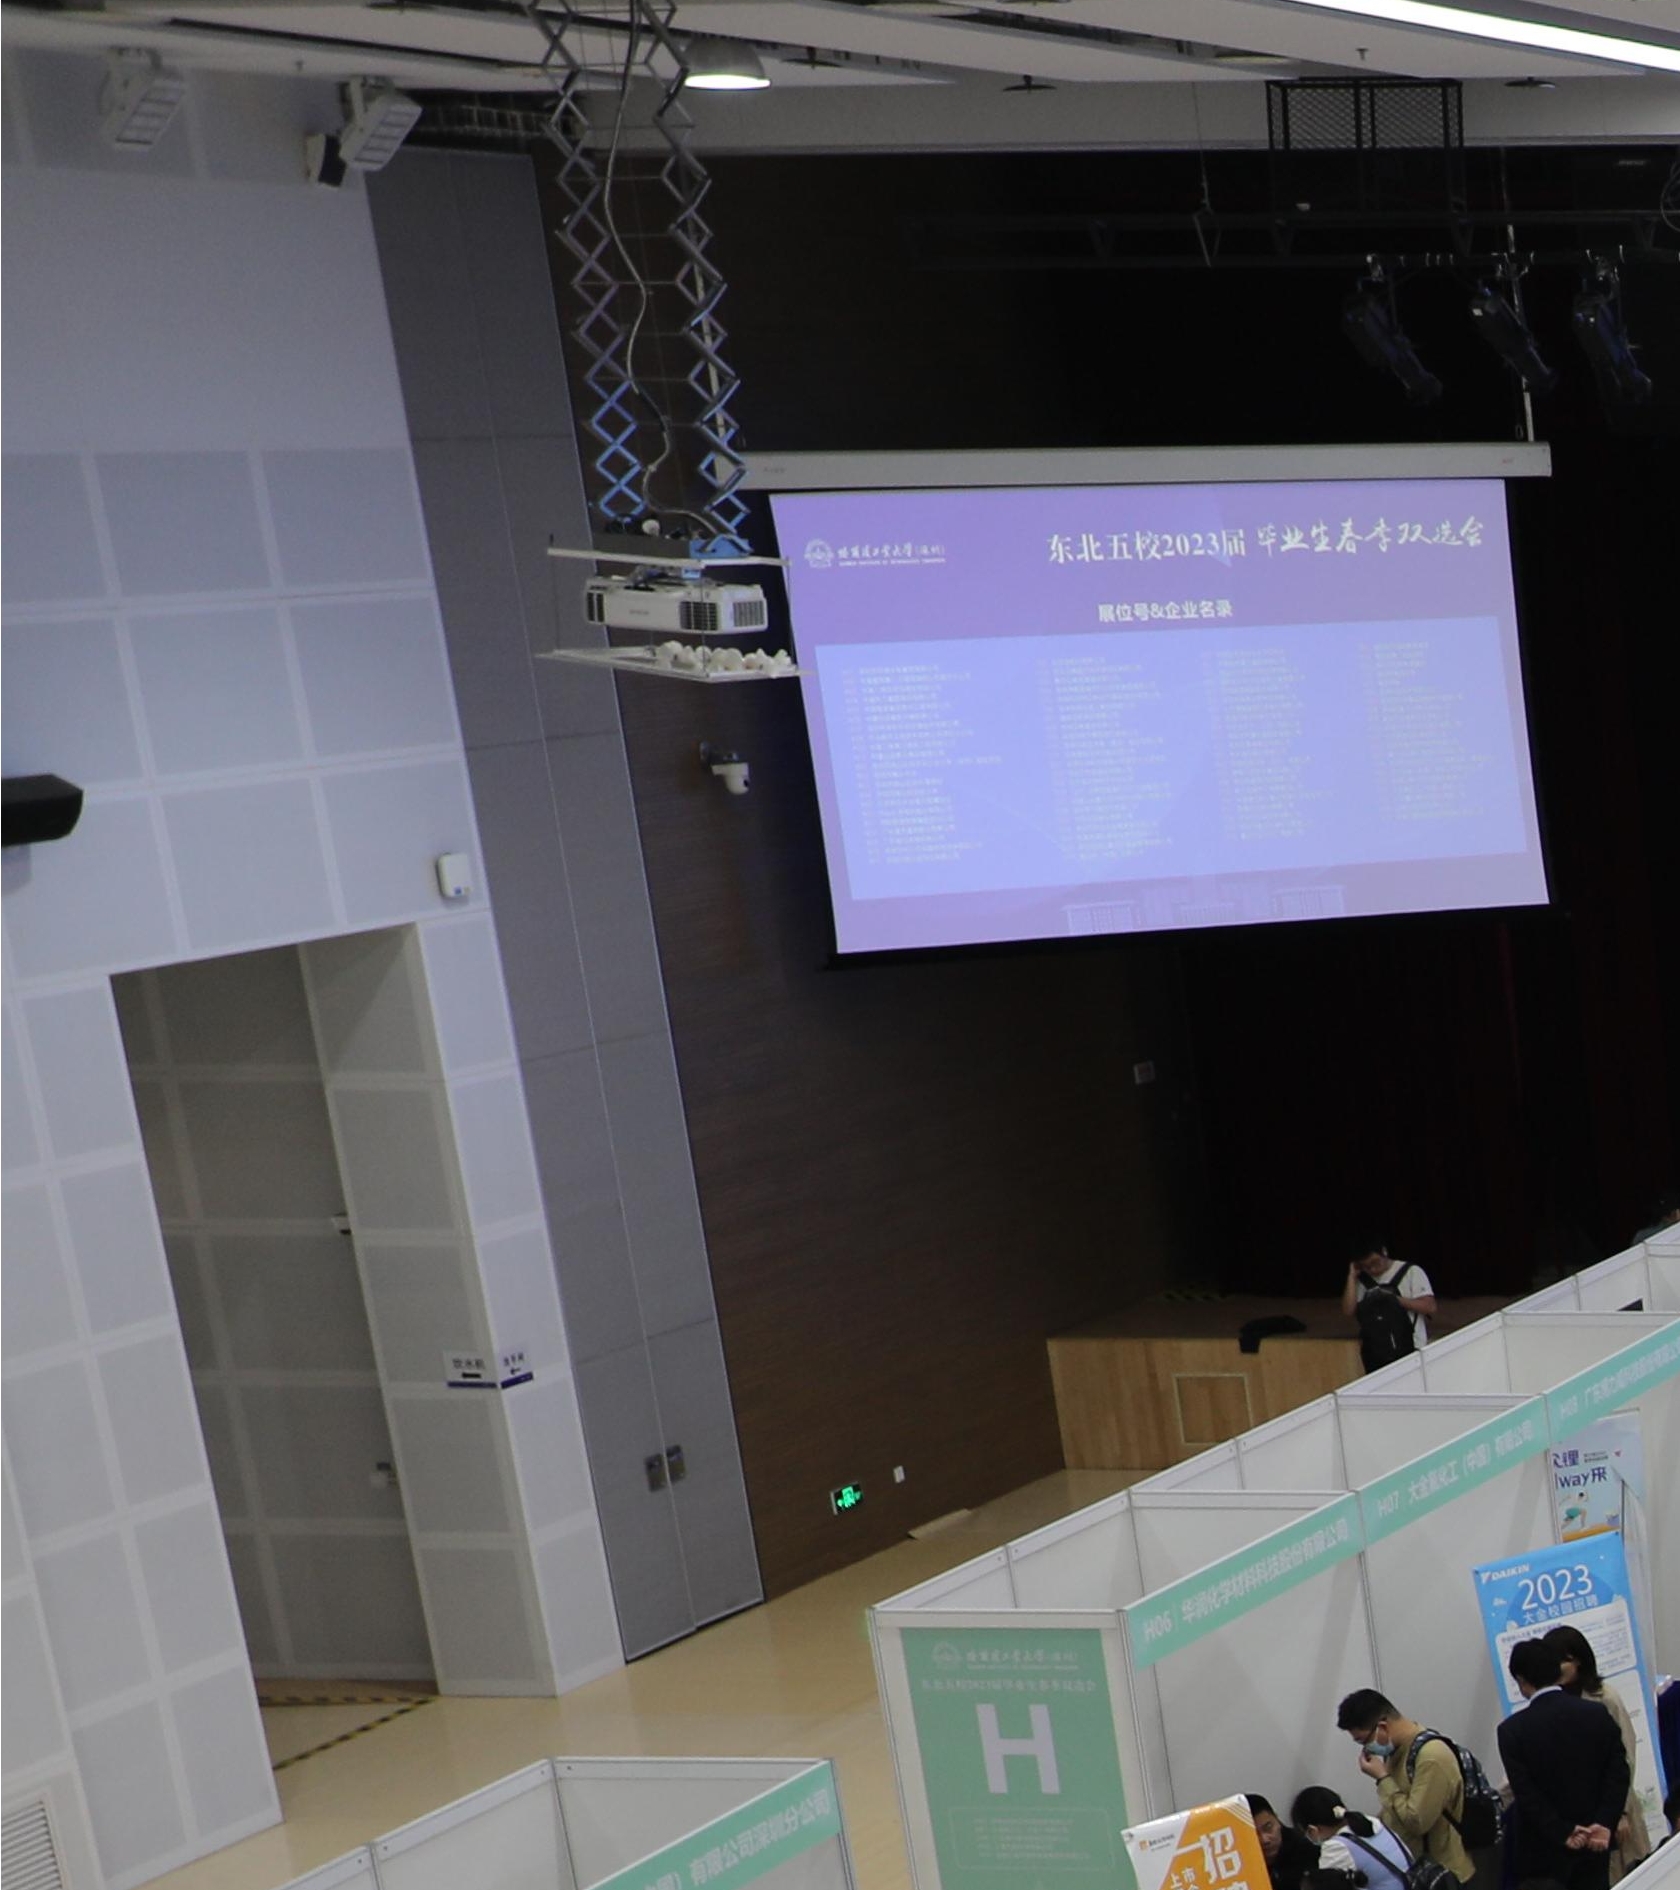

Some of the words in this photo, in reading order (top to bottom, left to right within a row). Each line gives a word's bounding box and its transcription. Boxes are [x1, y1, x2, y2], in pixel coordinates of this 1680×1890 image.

[1046, 526, 1248, 564] 东北五校2023届
[1255, 516, 1486, 555] 毕业生春季双选会
[1097, 598, 1235, 623] 展位号&企业名录
[1376, 1490, 1401, 1518] H07
[1491, 1563, 1531, 1582] DAIKIN
[1517, 1564, 1595, 1611] 2023
[1522, 1594, 1599, 1625] 大金校园招聘
[1142, 1612, 1174, 1642] H06
[975, 1703, 1062, 1795] H
